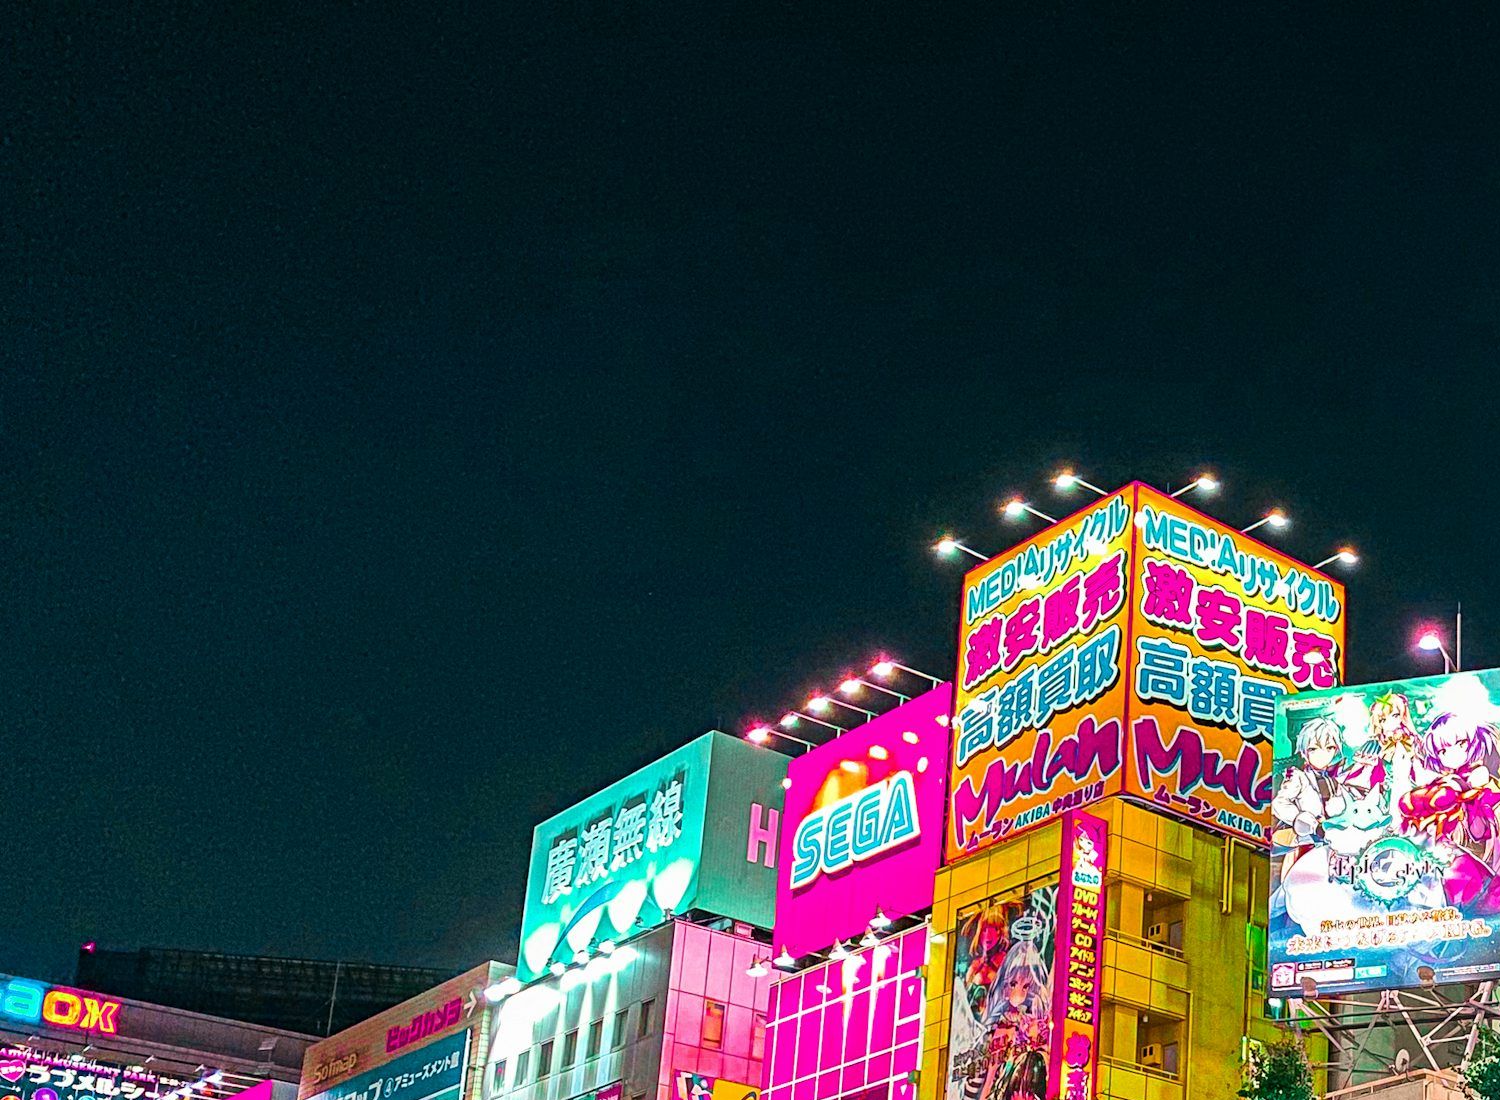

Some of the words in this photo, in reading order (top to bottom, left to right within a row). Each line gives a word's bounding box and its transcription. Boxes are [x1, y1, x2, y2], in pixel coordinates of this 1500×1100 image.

[966, 495, 1129, 626] MEDIAリサイクル
[1139, 507, 1340, 623] MEDIAリサイクル
[963, 550, 1128, 690] 激安販売
[1142, 561, 1338, 690] 激安販売
[957, 625, 1121, 767] 高額買取
[954, 715, 1123, 848] Mulan
[789, 769, 924, 892] SEGA
[968, 807, 1013, 852] ムーラン
[1014, 796, 1051, 829] AKIBA
[1154, 786, 1217, 820] ムーラン
[1218, 809, 1262, 838] AKIBA
[1074, 889, 1098, 905] DVD
[1075, 934, 1093, 948] CD
[1069, 962, 1095, 979] アニメ
[386, 997, 462, 1053] ビックカメラ
[123, 1070, 157, 1083] PARK
[313, 1052, 359, 1085] Sofmap
